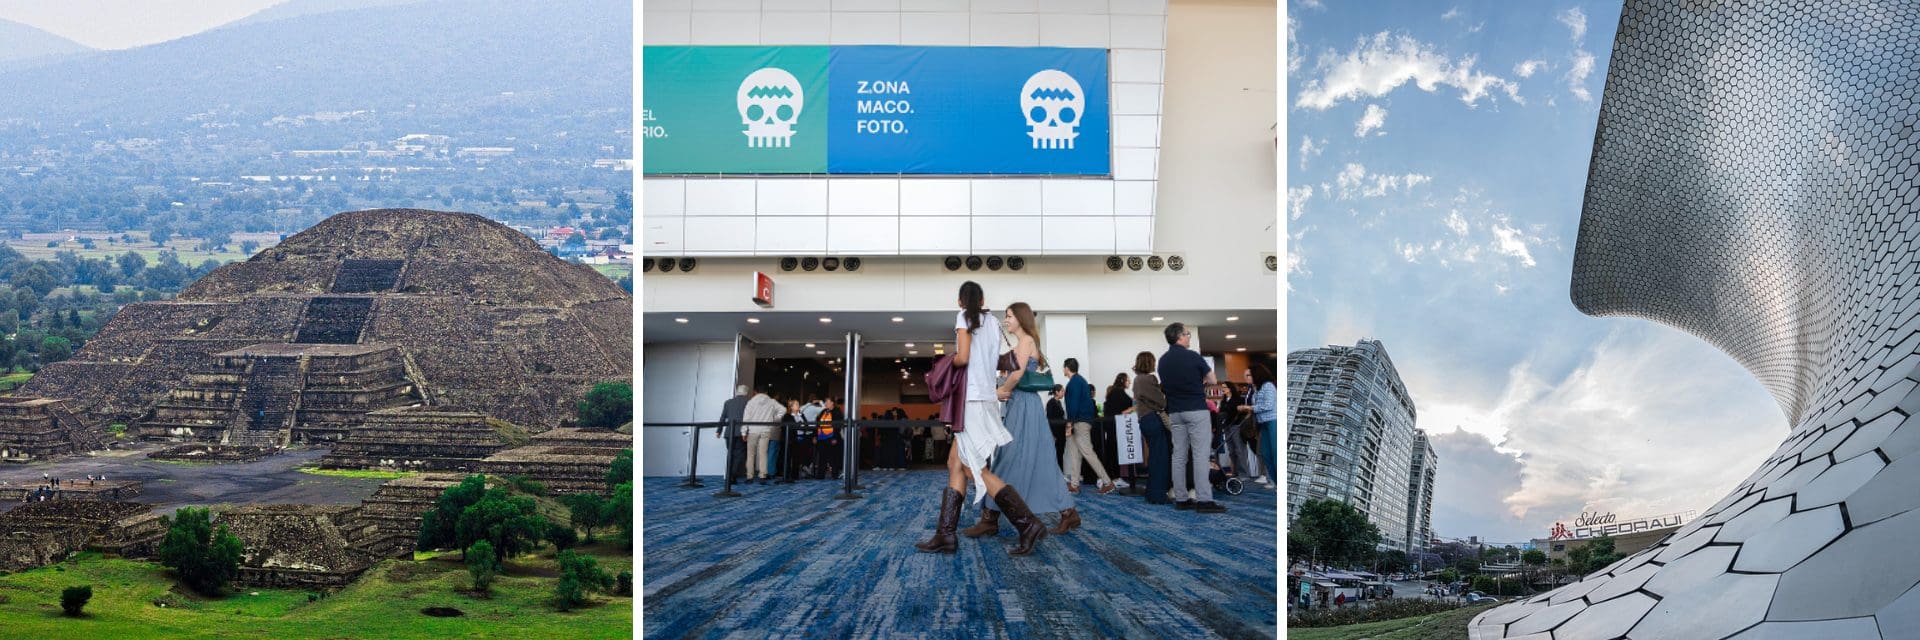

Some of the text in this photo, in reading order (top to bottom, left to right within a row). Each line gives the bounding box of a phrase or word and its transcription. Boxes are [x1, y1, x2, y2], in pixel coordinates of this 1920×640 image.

[857, 100, 914, 114] MACO.
[857, 120, 909, 133] FOTO.
[1125, 417, 1135, 460] GENERAL
[1575, 511, 1616, 527] Selecto
[1575, 515, 1682, 538] CHEDRAUI
